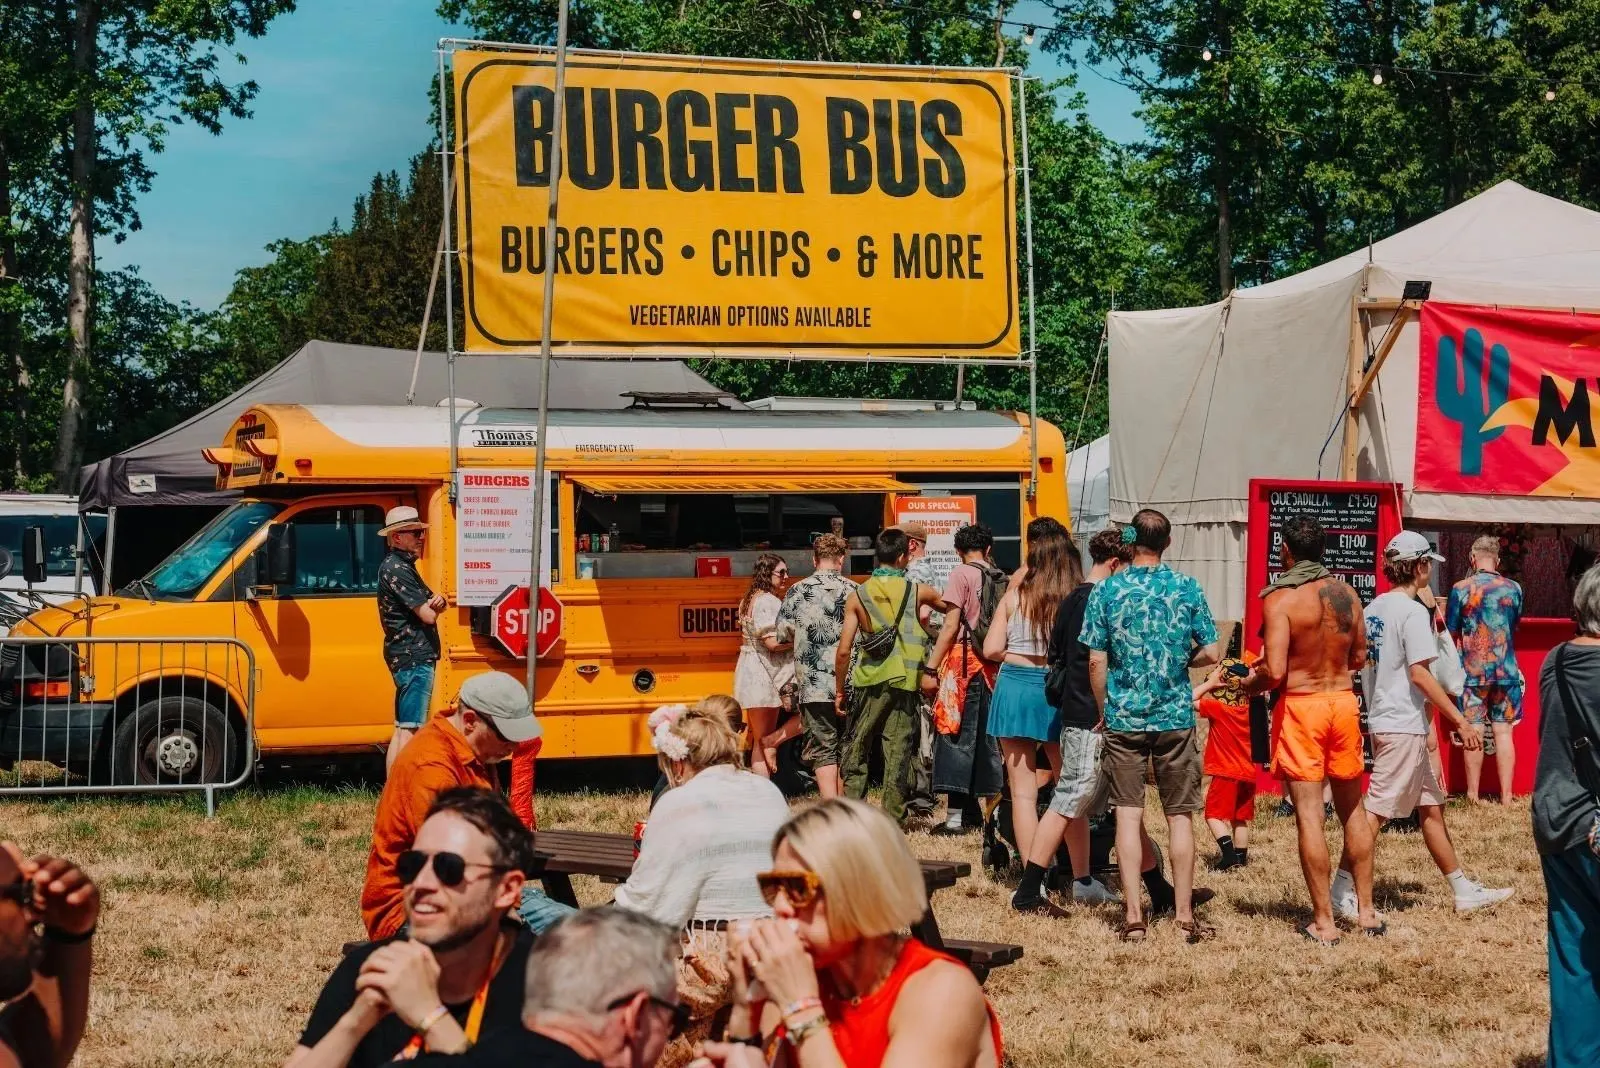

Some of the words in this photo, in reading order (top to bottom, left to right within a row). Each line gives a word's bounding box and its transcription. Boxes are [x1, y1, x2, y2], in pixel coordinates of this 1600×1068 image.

[512, 84, 805, 195] BURGER
[825, 96, 967, 198] BUS
[501, 225, 665, 276] BURGERS
[712, 229, 811, 278] CHIPS
[858, 236, 878, 278] &
[893, 233, 984, 280] MORE
[629, 304, 722, 327] VEGETARIAN
[727, 305, 789, 328] OPTIONS
[794, 306, 871, 328] AVAILABLE
[1532, 374, 1600, 447] M
[473, 430, 534, 441] Thomas
[575, 444, 617, 453] EMERGENCY
[619, 444, 634, 453] EXIT
[464, 475, 530, 487] BURGERS
[1271, 492, 1329, 507] QUESADILLA
[505, 608, 556, 635] STP
[683, 608, 742, 633] BURGE
